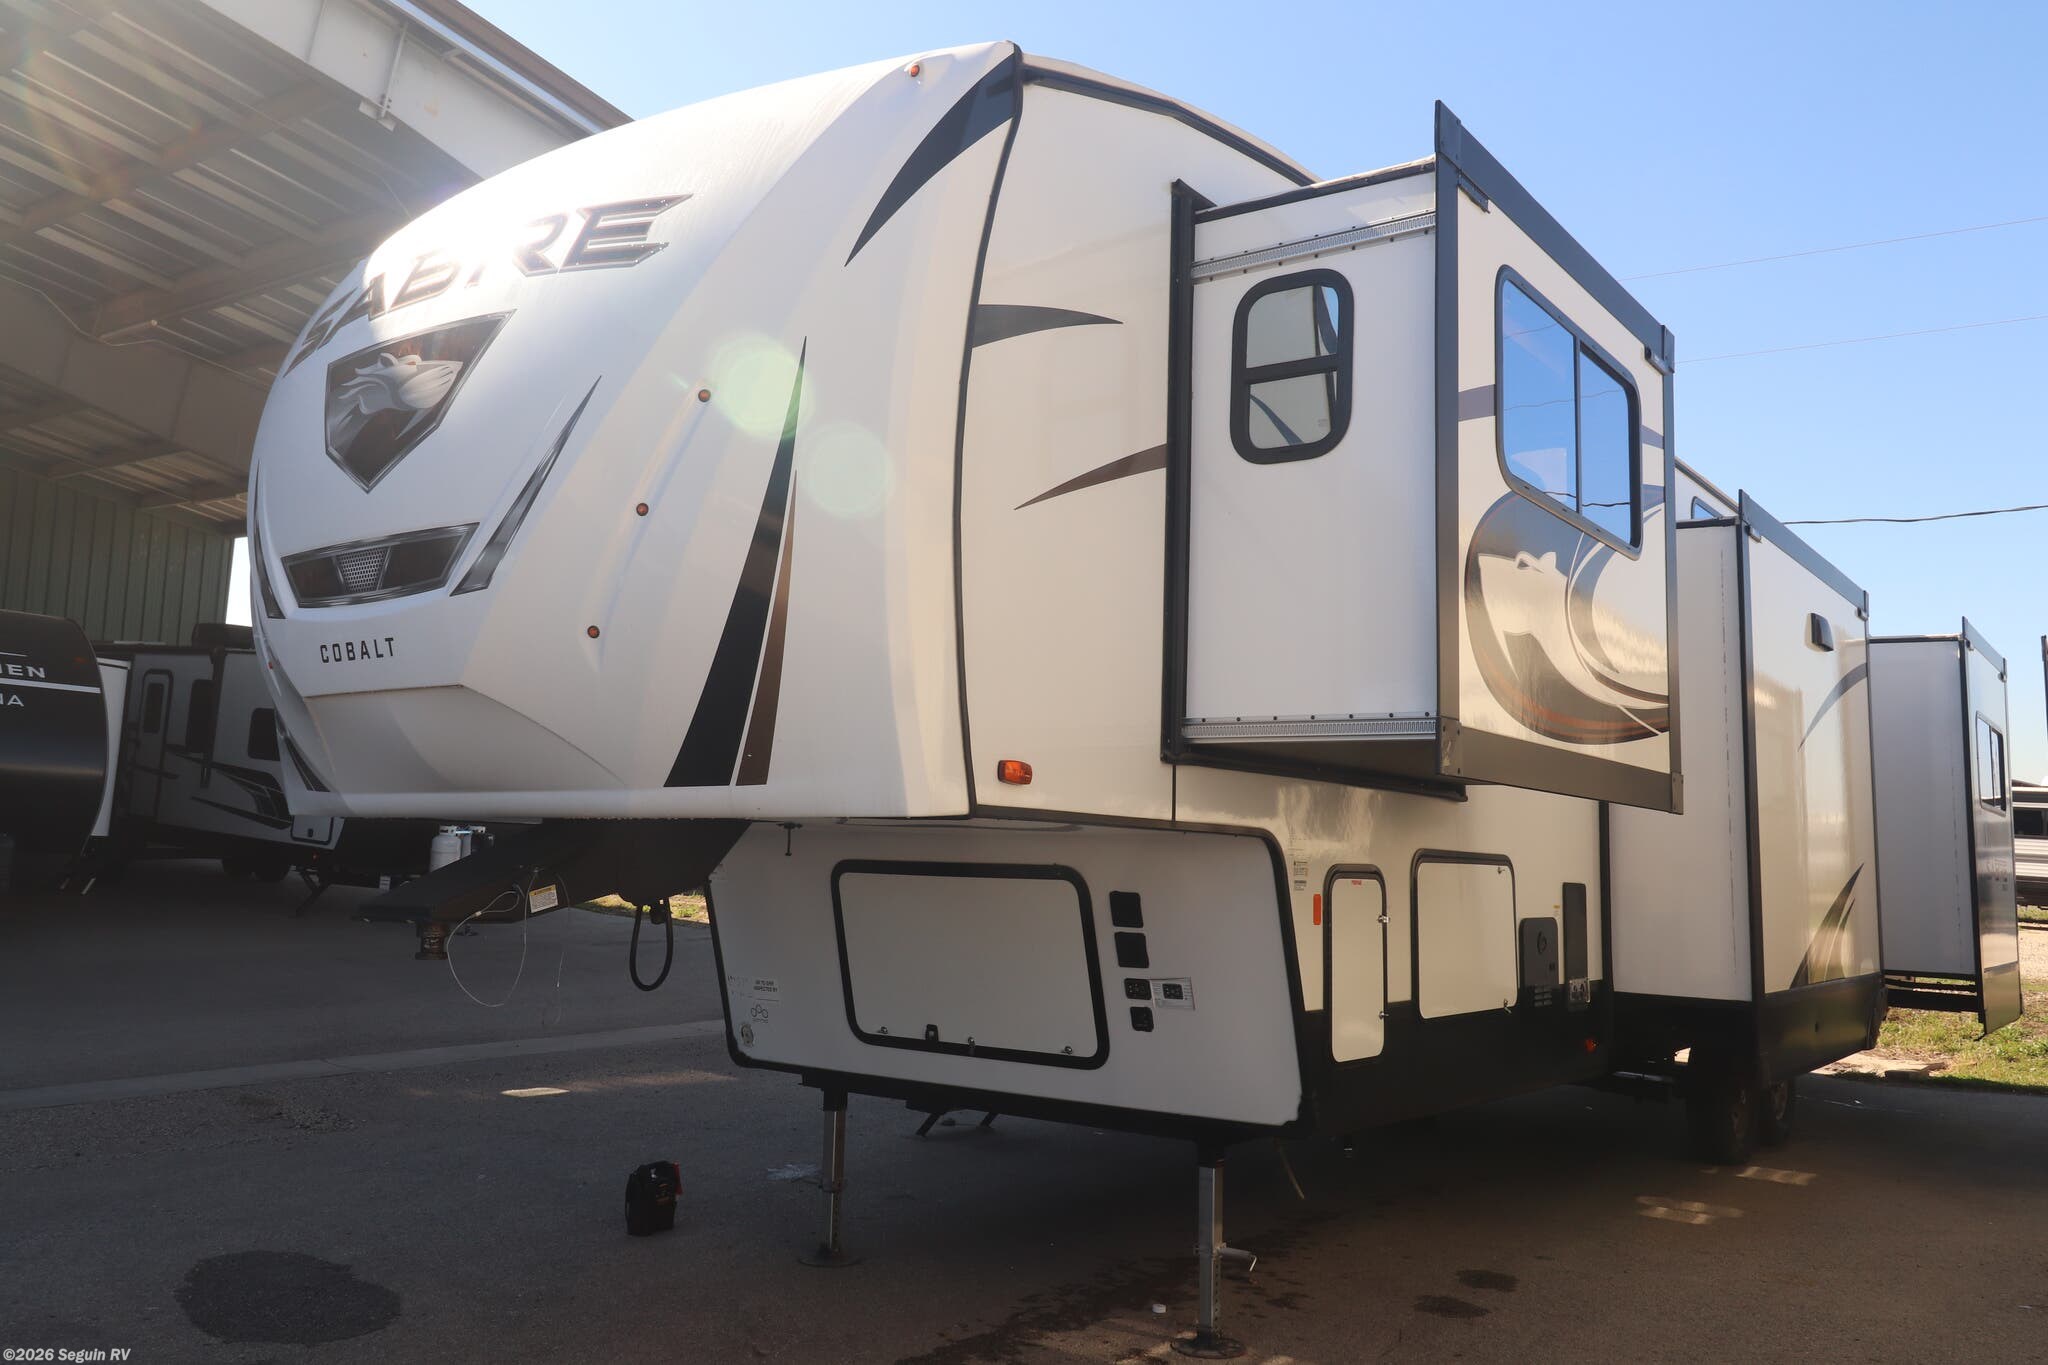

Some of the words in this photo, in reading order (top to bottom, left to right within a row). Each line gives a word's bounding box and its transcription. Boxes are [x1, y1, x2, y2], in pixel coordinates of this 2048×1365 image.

[320, 636, 395, 664] COBALT
[0, 663, 47, 679] EN
[0, 693, 26, 708] A
